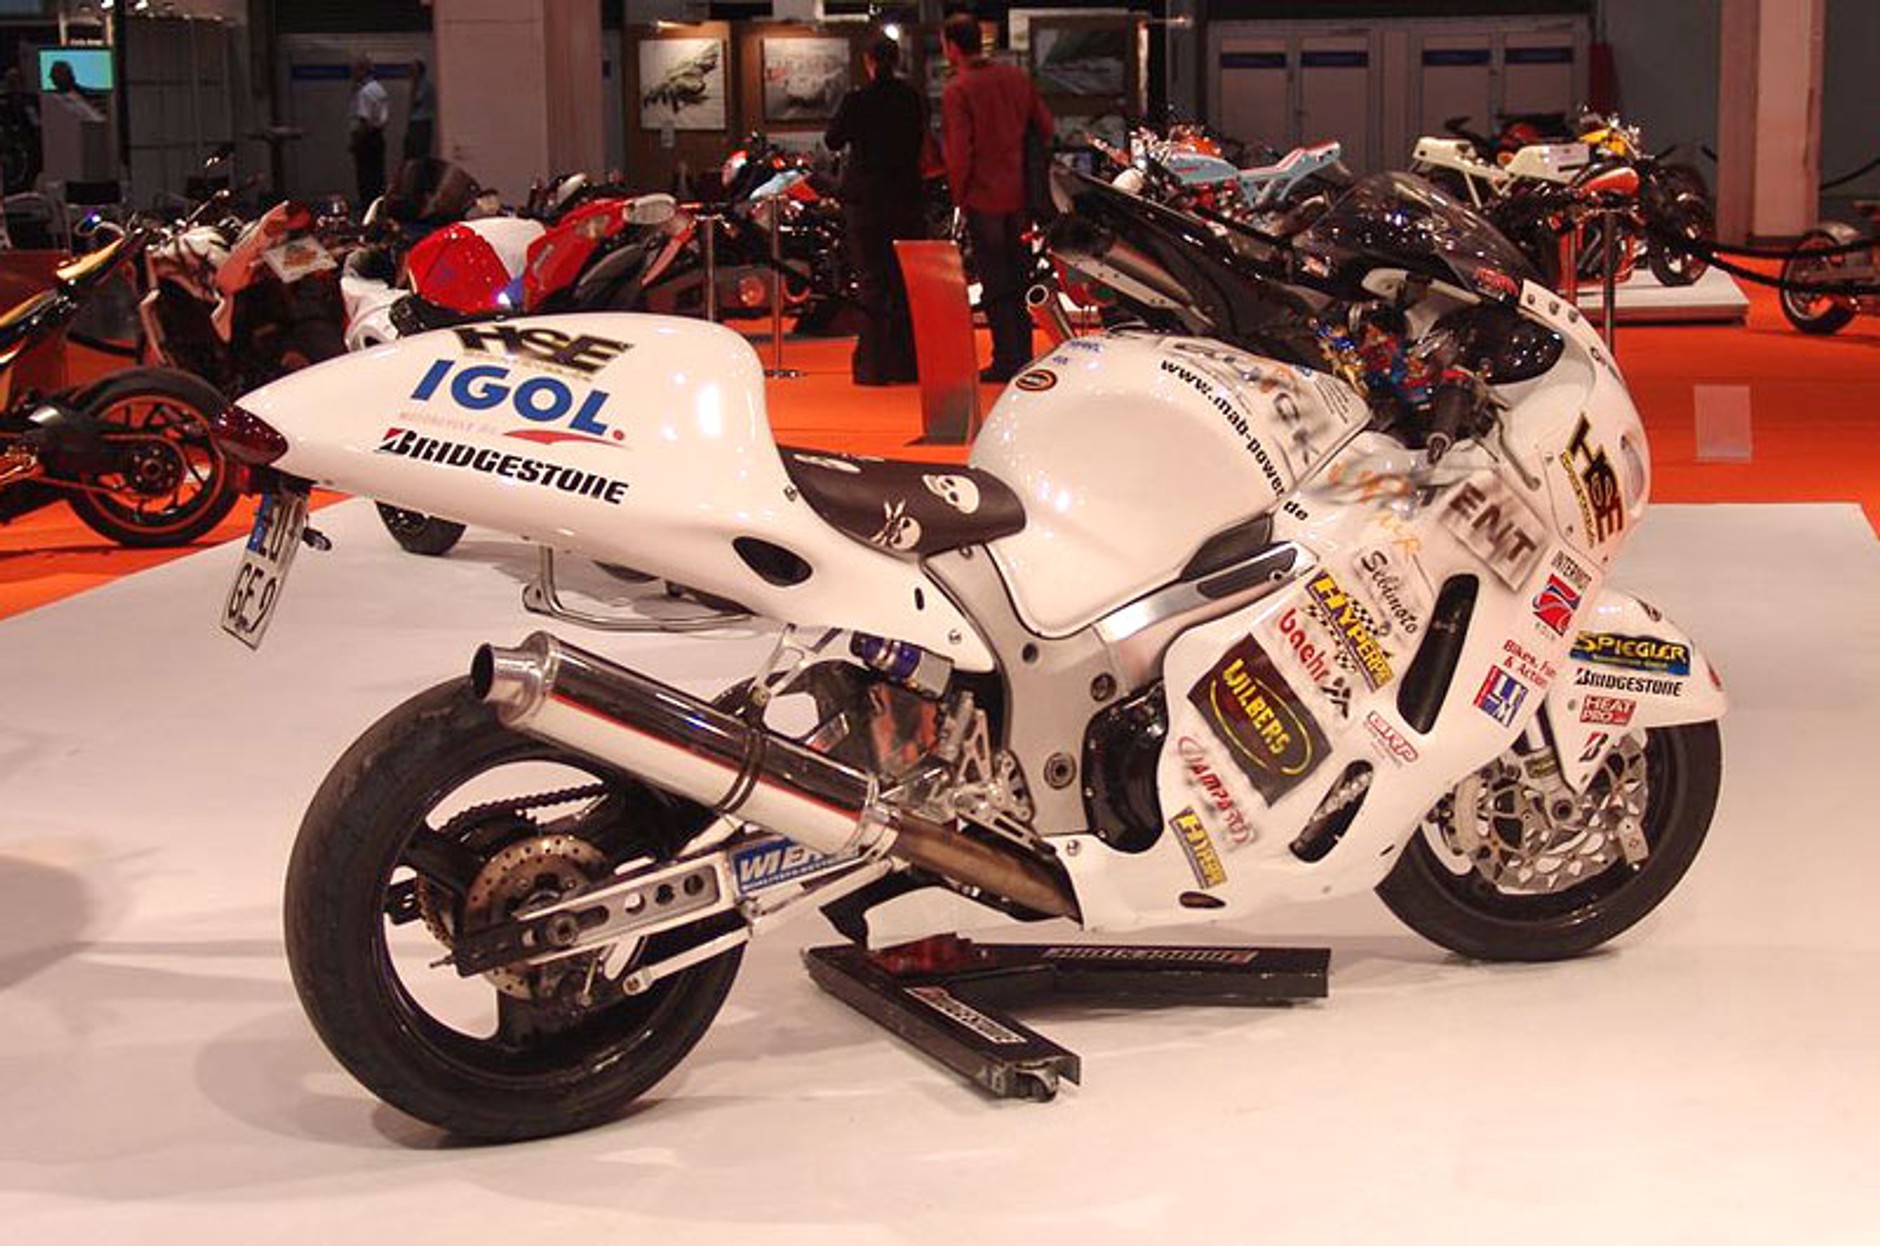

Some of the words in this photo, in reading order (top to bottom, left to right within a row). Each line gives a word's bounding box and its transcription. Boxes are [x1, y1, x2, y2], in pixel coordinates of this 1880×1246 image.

[378, 428, 630, 505] BRIDGESTONE
[1448, 481, 1538, 563] ENT
[1278, 607, 1331, 683] baehr
[1575, 667, 1684, 698] BRIDGESTONE
[1576, 630, 1689, 663] SPIEGLER
[1222, 658, 1291, 755] WILBERS
